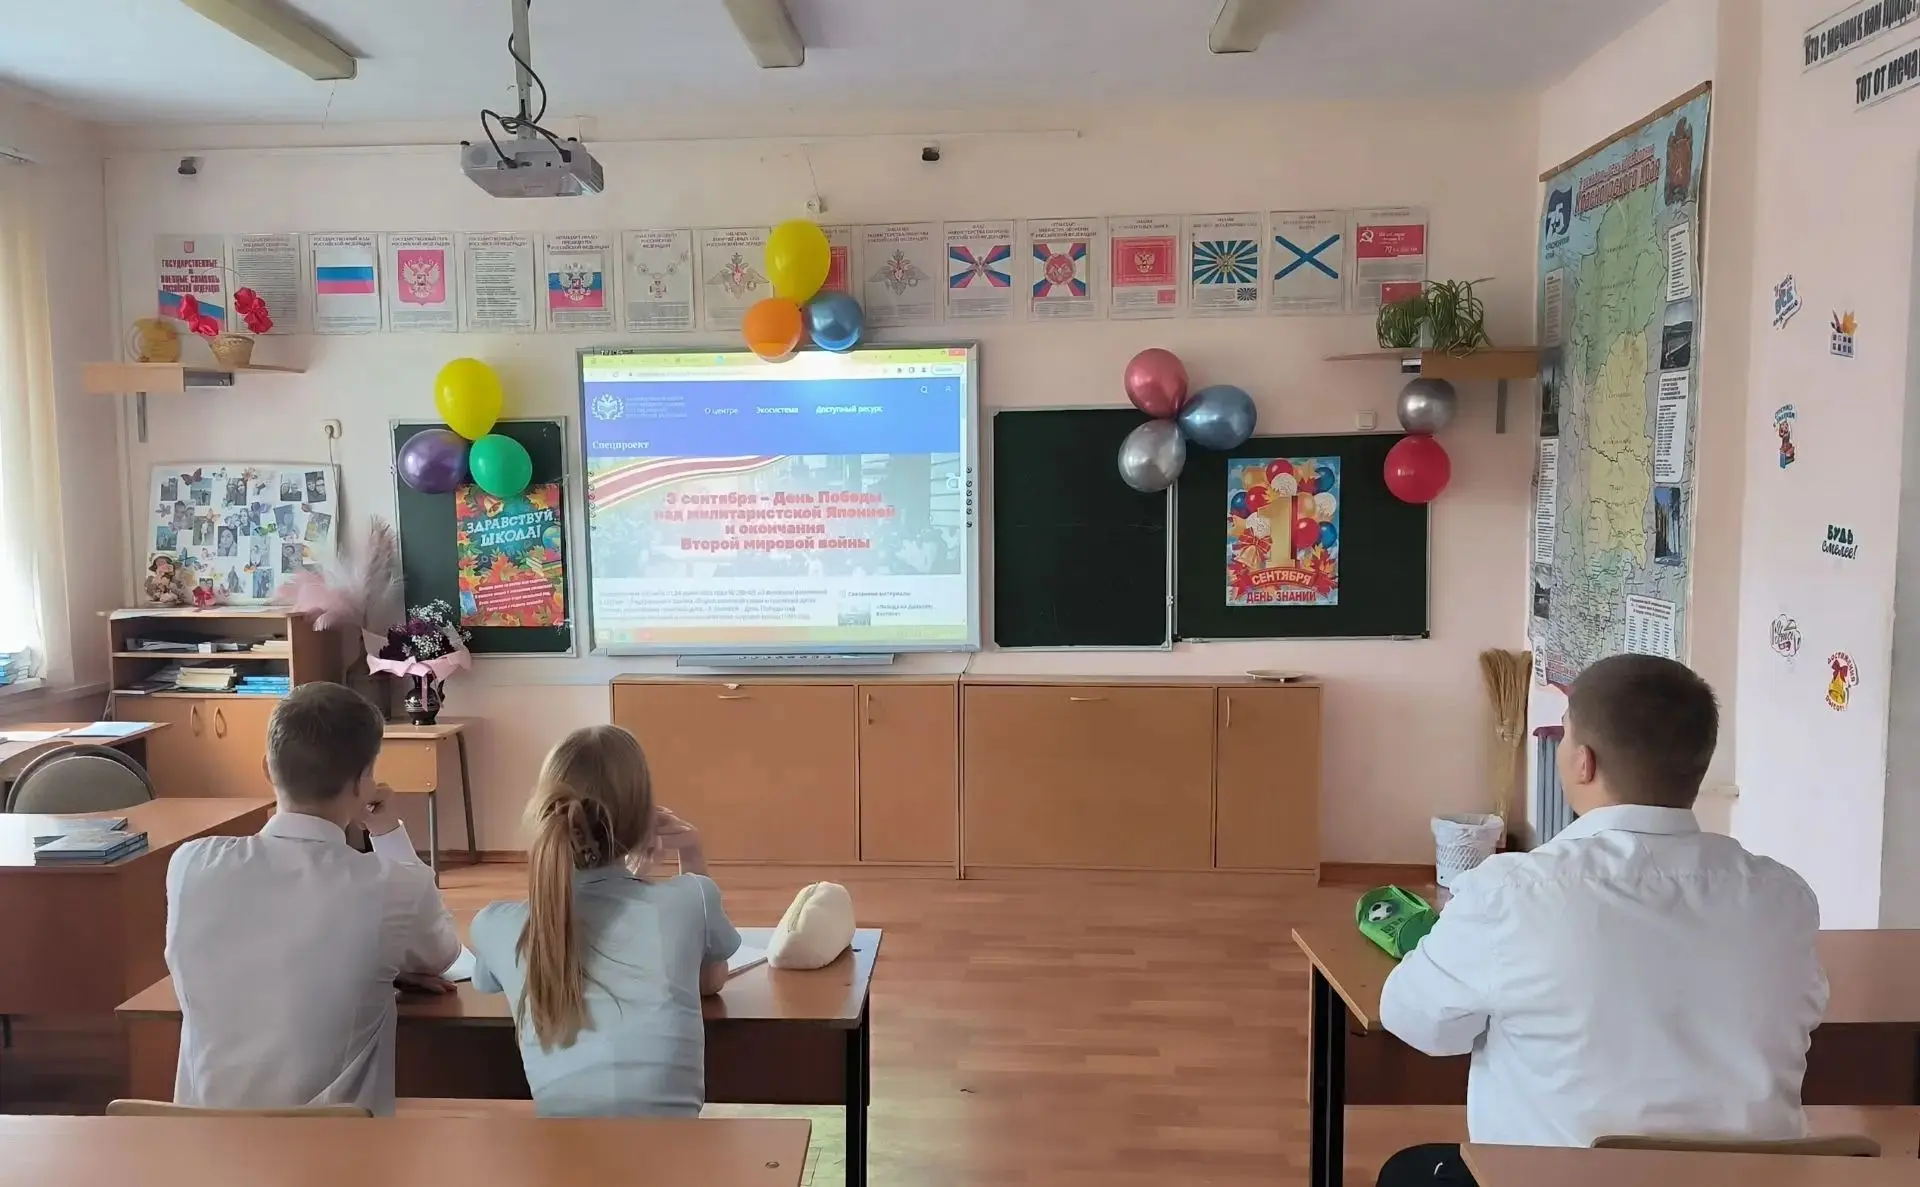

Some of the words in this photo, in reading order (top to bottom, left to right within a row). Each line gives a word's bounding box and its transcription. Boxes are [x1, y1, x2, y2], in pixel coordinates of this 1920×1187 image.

[592, 440, 649, 450] Спецпроект
[667, 492, 676, 505] 3
[681, 492, 757, 507] сентября
[773, 491, 814, 506] День
[818, 490, 882, 505] Победы
[826, 504, 896, 518] Японией
[480, 525, 541, 547] ШКОЛА!
[725, 525, 735, 534] и
[739, 524, 825, 534] окончания
[1827, 524, 1854, 545] БУДЬ
[681, 536, 740, 553] Второй
[744, 535, 814, 552] мировой
[818, 535, 870, 549] войны
[1251, 570, 1312, 586] СЕНТЯБРЯ
[1247, 591, 1273, 603] ДЕНЬ
